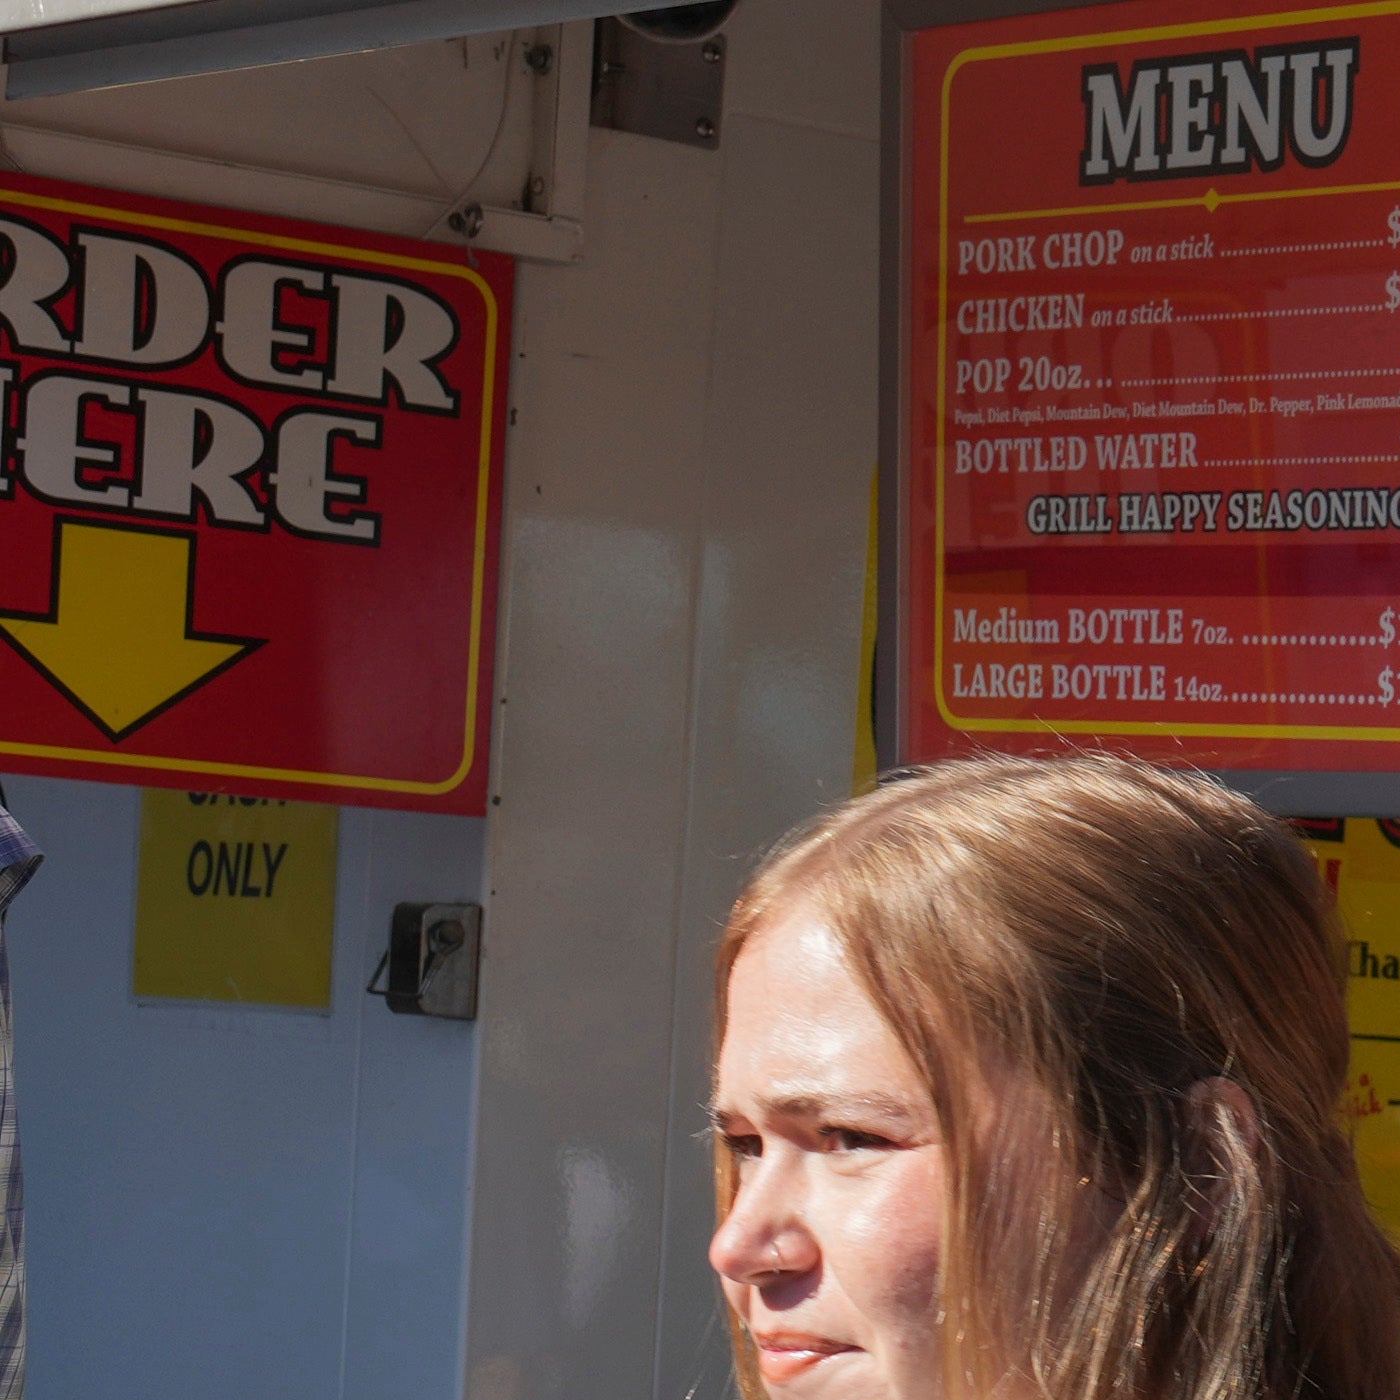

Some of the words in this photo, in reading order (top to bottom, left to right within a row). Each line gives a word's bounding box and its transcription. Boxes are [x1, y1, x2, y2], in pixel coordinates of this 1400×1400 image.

[1083, 45, 1355, 179] MENU
[958, 235, 1037, 275] PORK
[1043, 229, 1124, 270] CHOP
[1131, 244, 1152, 263] on
[1156, 243, 1167, 262] a
[1171, 233, 1214, 261] stick
[0, 215, 459, 411] RDER
[957, 293, 1085, 335] CHICKEN
[1091, 309, 1112, 327] on
[1116, 308, 1127, 325] a
[1130, 299, 1174, 325] stick
[956, 357, 1011, 394] POP
[988, 407, 1010, 424] Diet
[1012, 405, 1044, 427] Pepsi,
[1046, 402, 1101, 422] Mountain
[1103, 402, 1130, 421] Dew,
[1133, 401, 1155, 418] Diet
[1159, 399, 1215, 418] Mountain
[1218, 398, 1247, 416] Dew,
[1249, 397, 1267, 413] Dr.
[1270, 396, 1314, 417] Pepper,
[1317, 394, 1345, 411] Pink
[0, 364, 380, 543] ERE
[955, 436, 1088, 474] BOTTLED
[1096, 432, 1199, 471] WATER
[1026, 495, 1112, 534] GRILL
[1117, 492, 1224, 532] HAPPY
[953, 607, 1060, 644] Medium
[1067, 608, 1184, 645] BOTTLE
[953, 663, 1044, 698] LARGE
[1051, 664, 1167, 701] BOTTLE
[187, 841, 288, 899] ONLY
